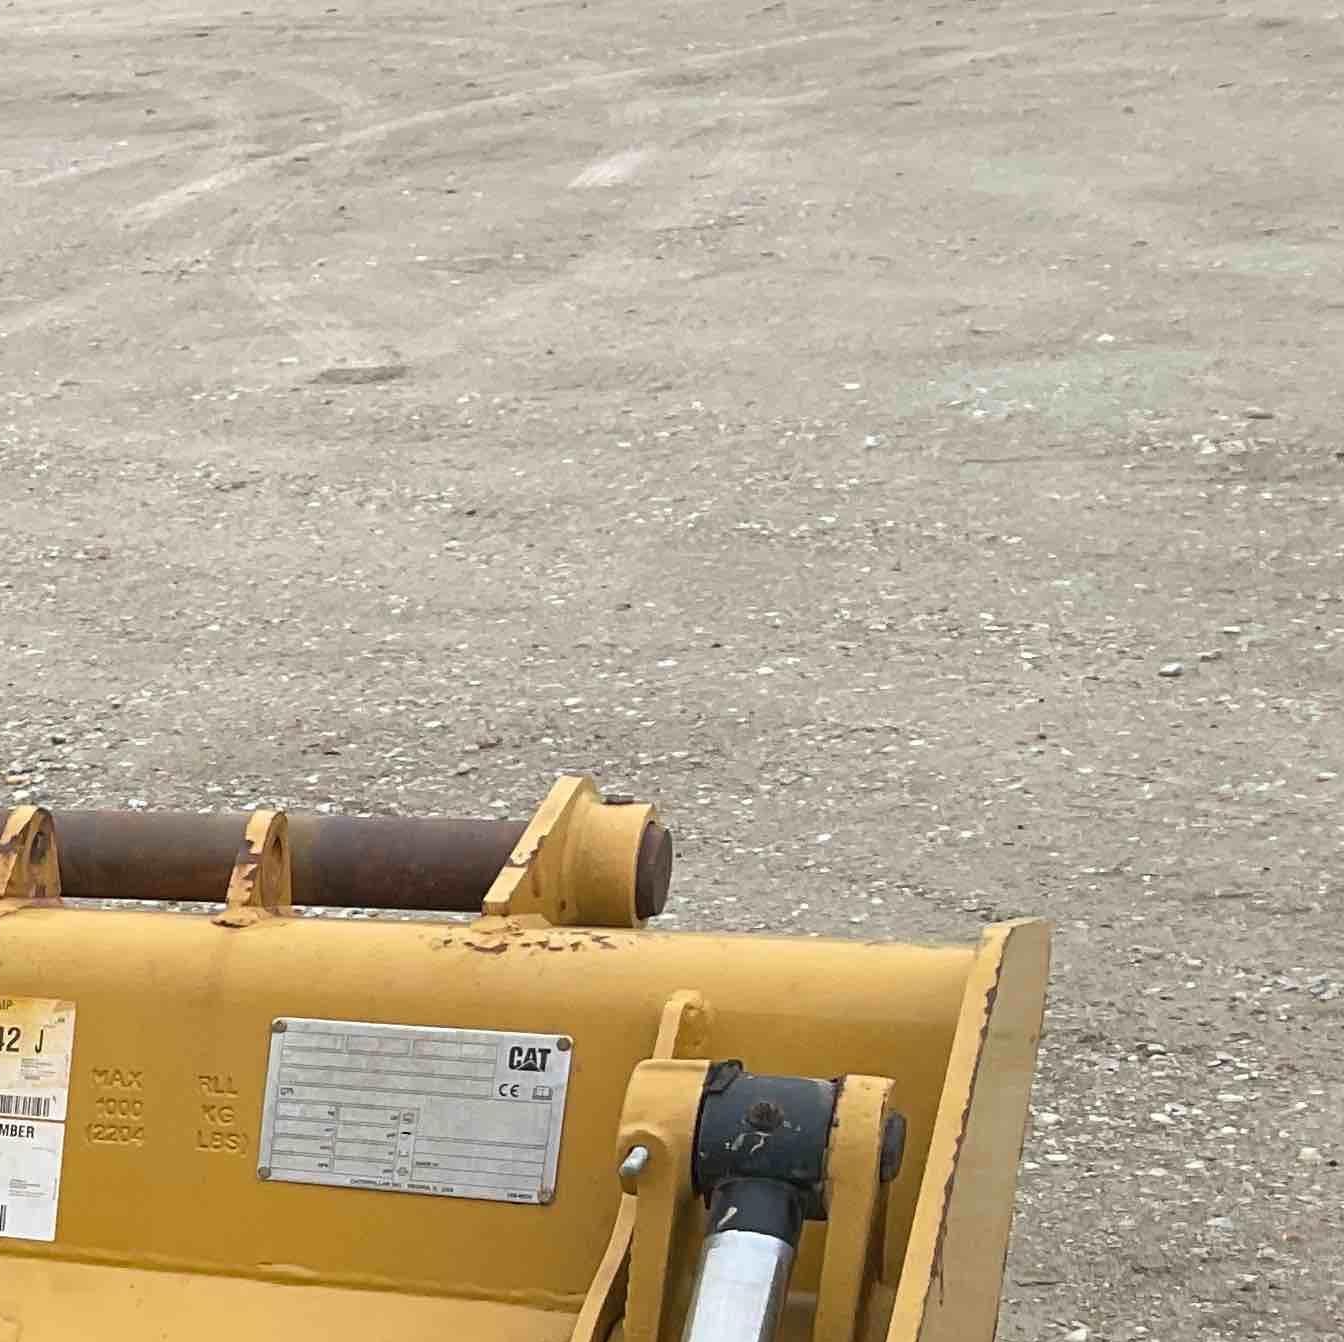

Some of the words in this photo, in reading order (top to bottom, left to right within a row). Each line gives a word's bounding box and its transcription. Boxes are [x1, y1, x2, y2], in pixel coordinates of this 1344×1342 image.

[34, 1028, 45, 1054] J
[507, 1045, 552, 1073] CAT
[90, 1067, 143, 1089] MAX
[94, 1097, 145, 1120] 1000
[199, 1103, 236, 1126] KG
